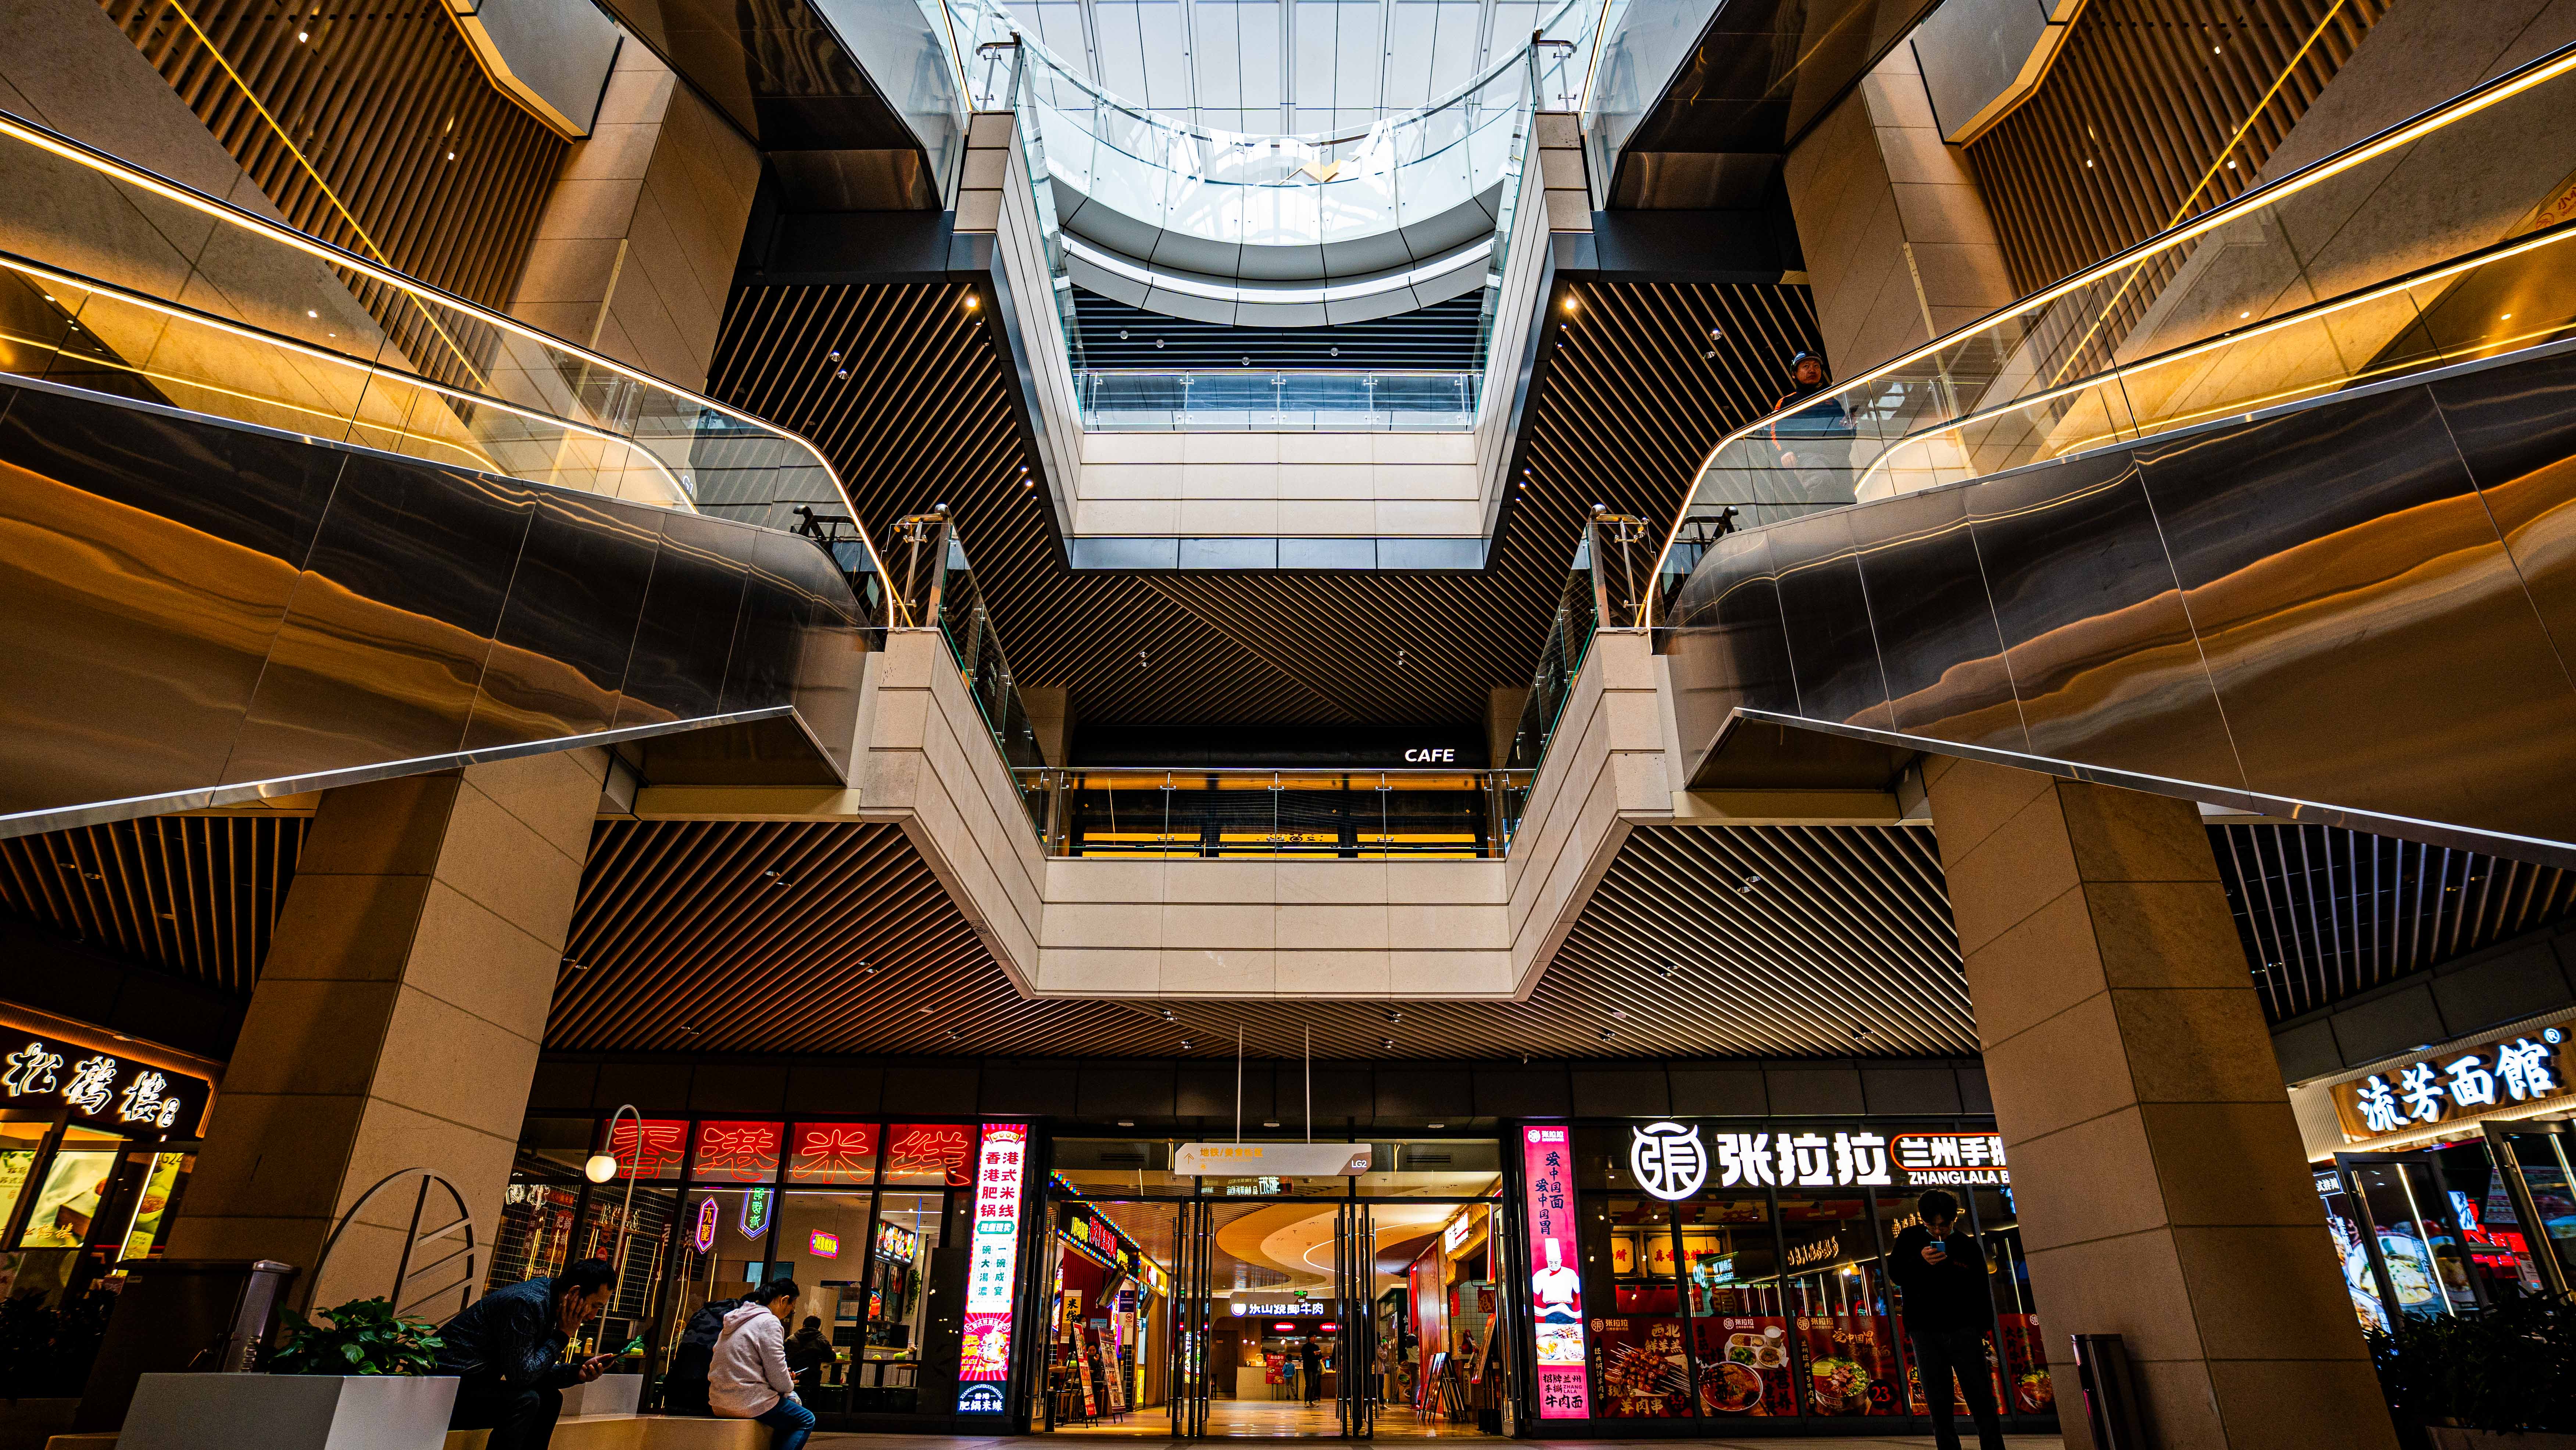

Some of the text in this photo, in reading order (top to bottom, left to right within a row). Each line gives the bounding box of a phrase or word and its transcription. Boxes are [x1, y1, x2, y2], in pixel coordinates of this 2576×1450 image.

[1405, 749, 1455, 762] CAFE
[2357, 1038, 2557, 1131] 流芳面館
[1717, 1132, 1891, 1187] 张拉拉
[1909, 1171, 1999, 1184] ZHANGLALA
[1066, 1298, 1079, 1321] 米线
[1652, 1324, 1680, 1338] 西北
[1543, 1374, 1581, 1383] 招牌兰州
[1871, 1386, 1890, 1401] 23
[1545, 1394, 1583, 1409] 牛肉面
[1620, 1397, 1663, 1414] 羊肉串
